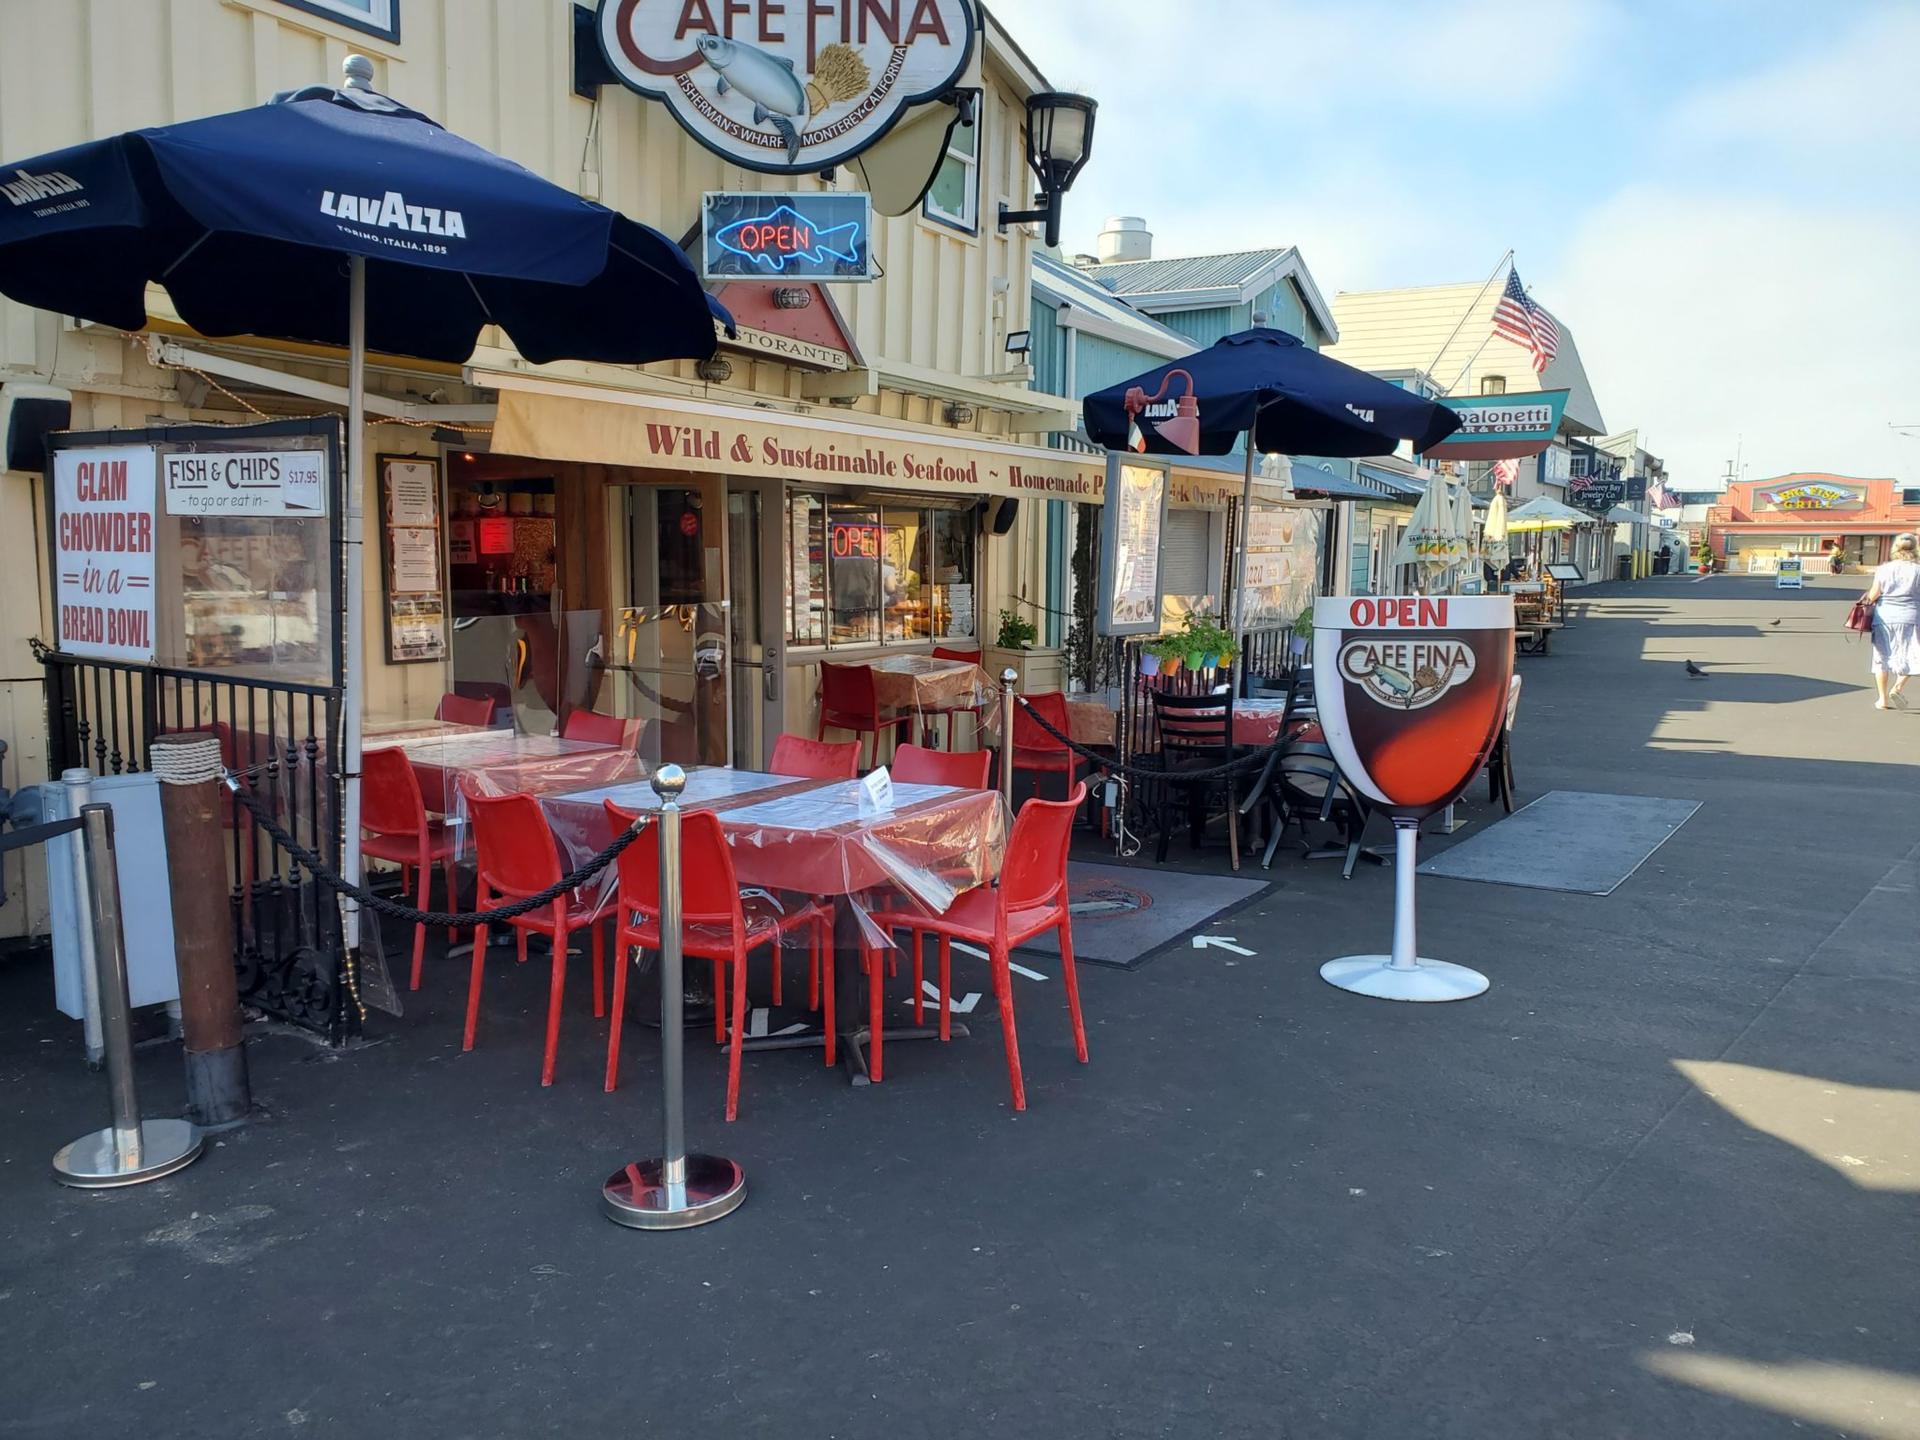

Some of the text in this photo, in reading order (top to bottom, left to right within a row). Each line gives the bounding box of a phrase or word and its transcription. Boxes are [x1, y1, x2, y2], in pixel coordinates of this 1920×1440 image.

[616, 0, 950, 76] CAFE FINA
[677, 73, 739, 136] FISHERMAN'S
[740, 129, 784, 149] WHARF
[320, 190, 466, 239] LAVAZZA
[740, 225, 810, 250] OPEN
[1457, 425, 1475, 433] AR
[1495, 424, 1545, 433] GRILL
[1458, 408, 1548, 423] balonetti
[169, 457, 280, 489] FISH & CHIPS
[645, 423, 721, 461] Wild
[730, 433, 753, 464] &
[762, 436, 897, 478] Sustainable
[903, 453, 978, 484] Seafood
[1008, 465, 1090, 495] Homemade
[77, 461, 128, 502] CLAM
[289, 471, 317, 485] $17.95
[200, 496, 214, 512] go
[231, 495, 249, 506] eat
[1783, 500, 1833, 509] GRILL
[60, 512, 151, 552] CHOWDER
[833, 526, 887, 557] OPEN
[63, 605, 150, 648] BREAD BOWL
[1350, 598, 1448, 627] OPEN
[1343, 644, 1469, 679] CAFE FINA
